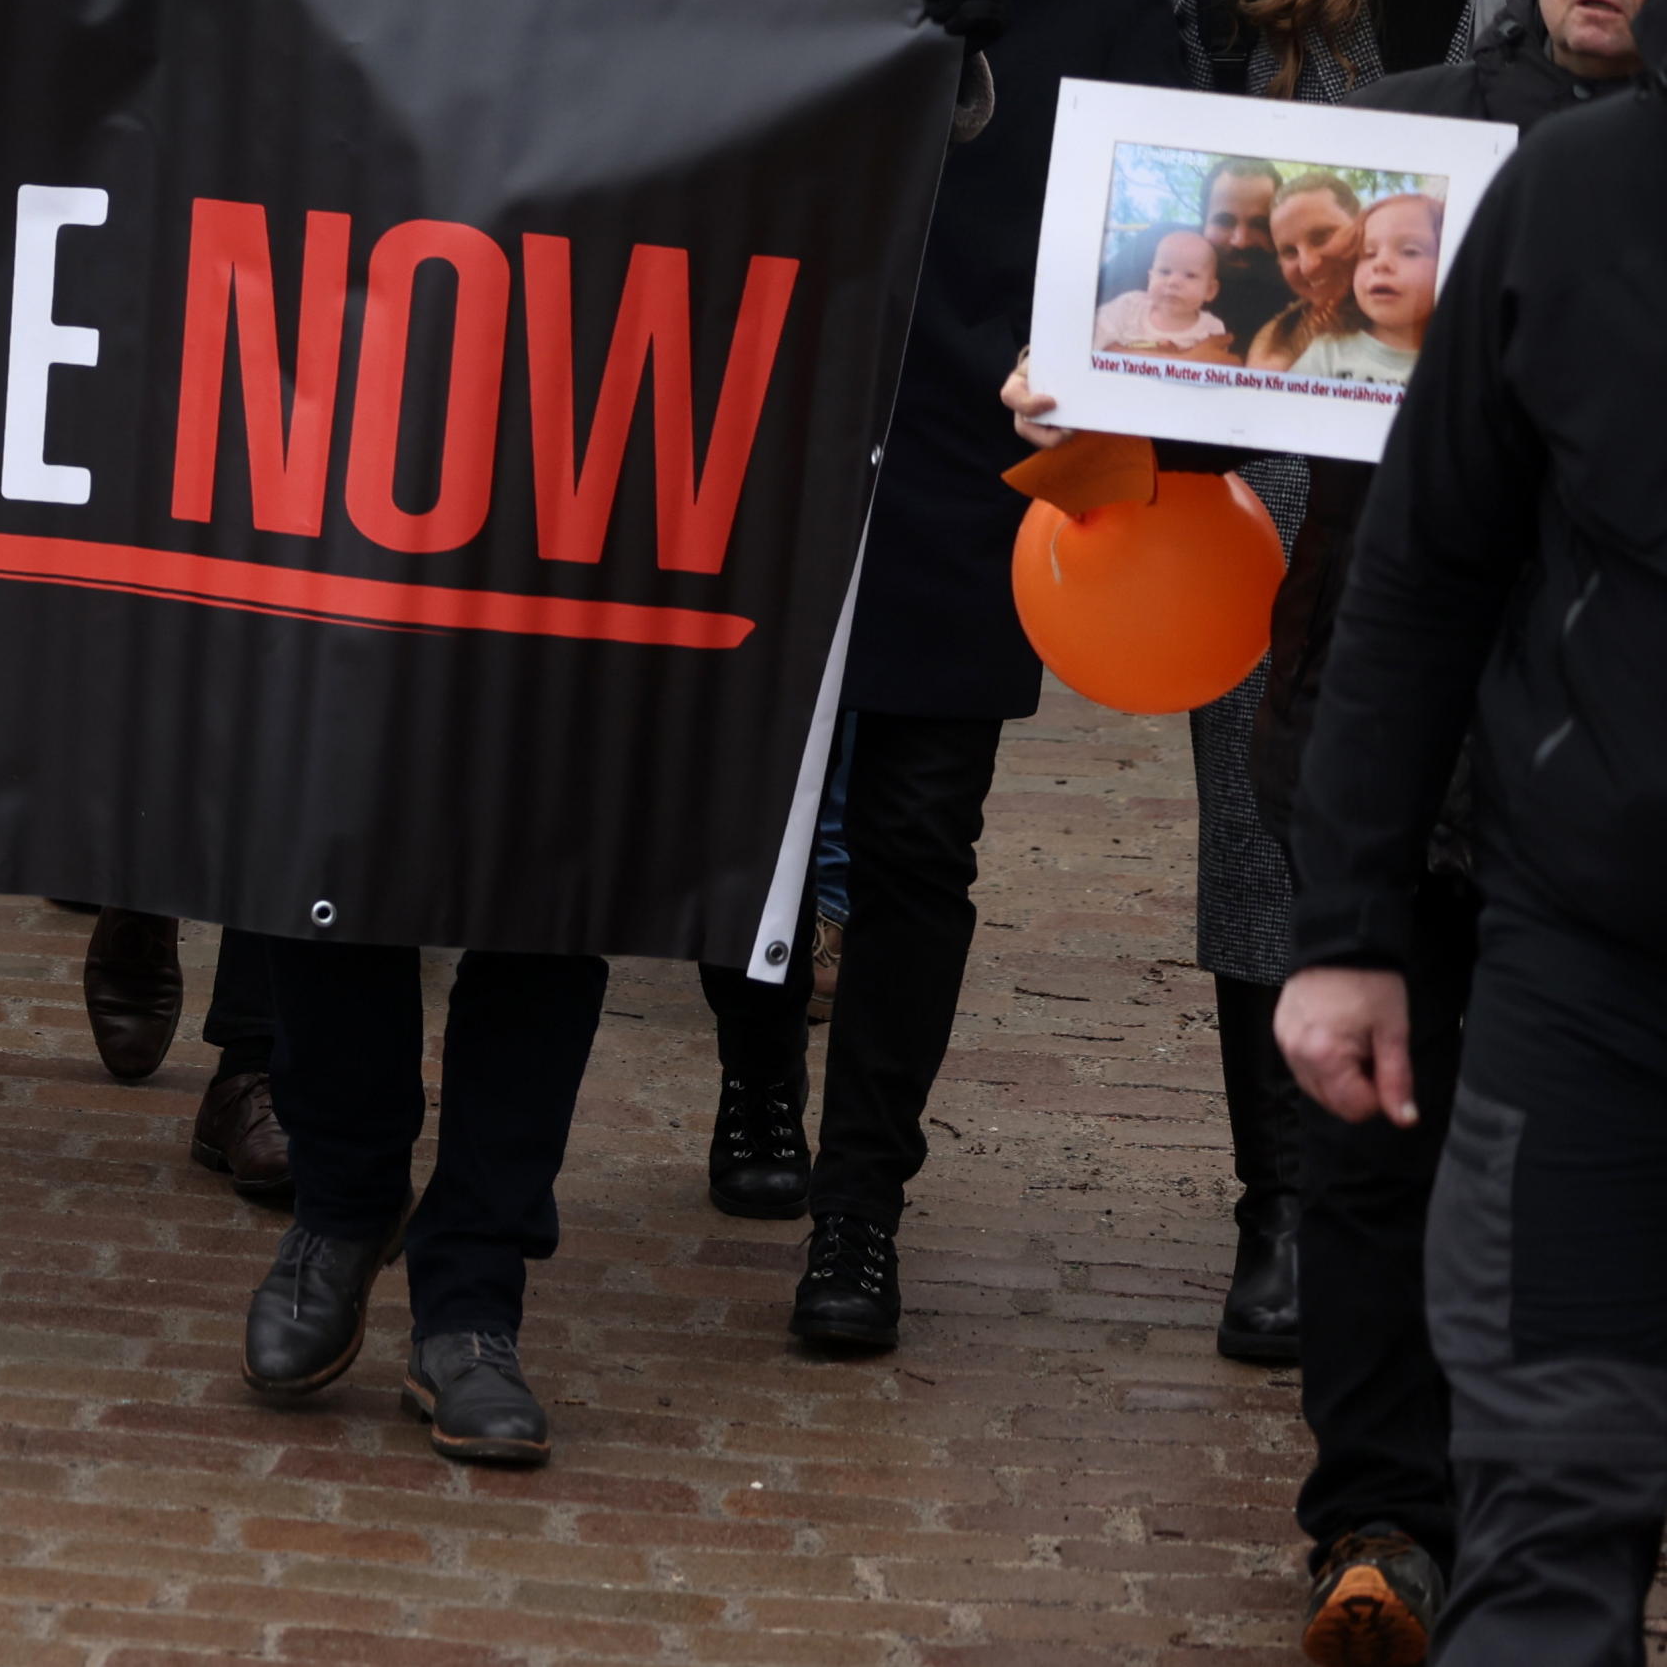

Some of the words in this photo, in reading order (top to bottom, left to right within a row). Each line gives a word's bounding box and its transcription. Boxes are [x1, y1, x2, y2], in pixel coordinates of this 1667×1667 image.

[171, 196, 800, 574] NOW
[1091, 355, 1120, 371] Vater
[1122, 358, 1161, 378] Yarden,
[1165, 364, 1202, 381] Mutter
[1235, 372, 1263, 390] Baby
[1287, 379, 1309, 393] und
[1311, 381, 1329, 396] der
